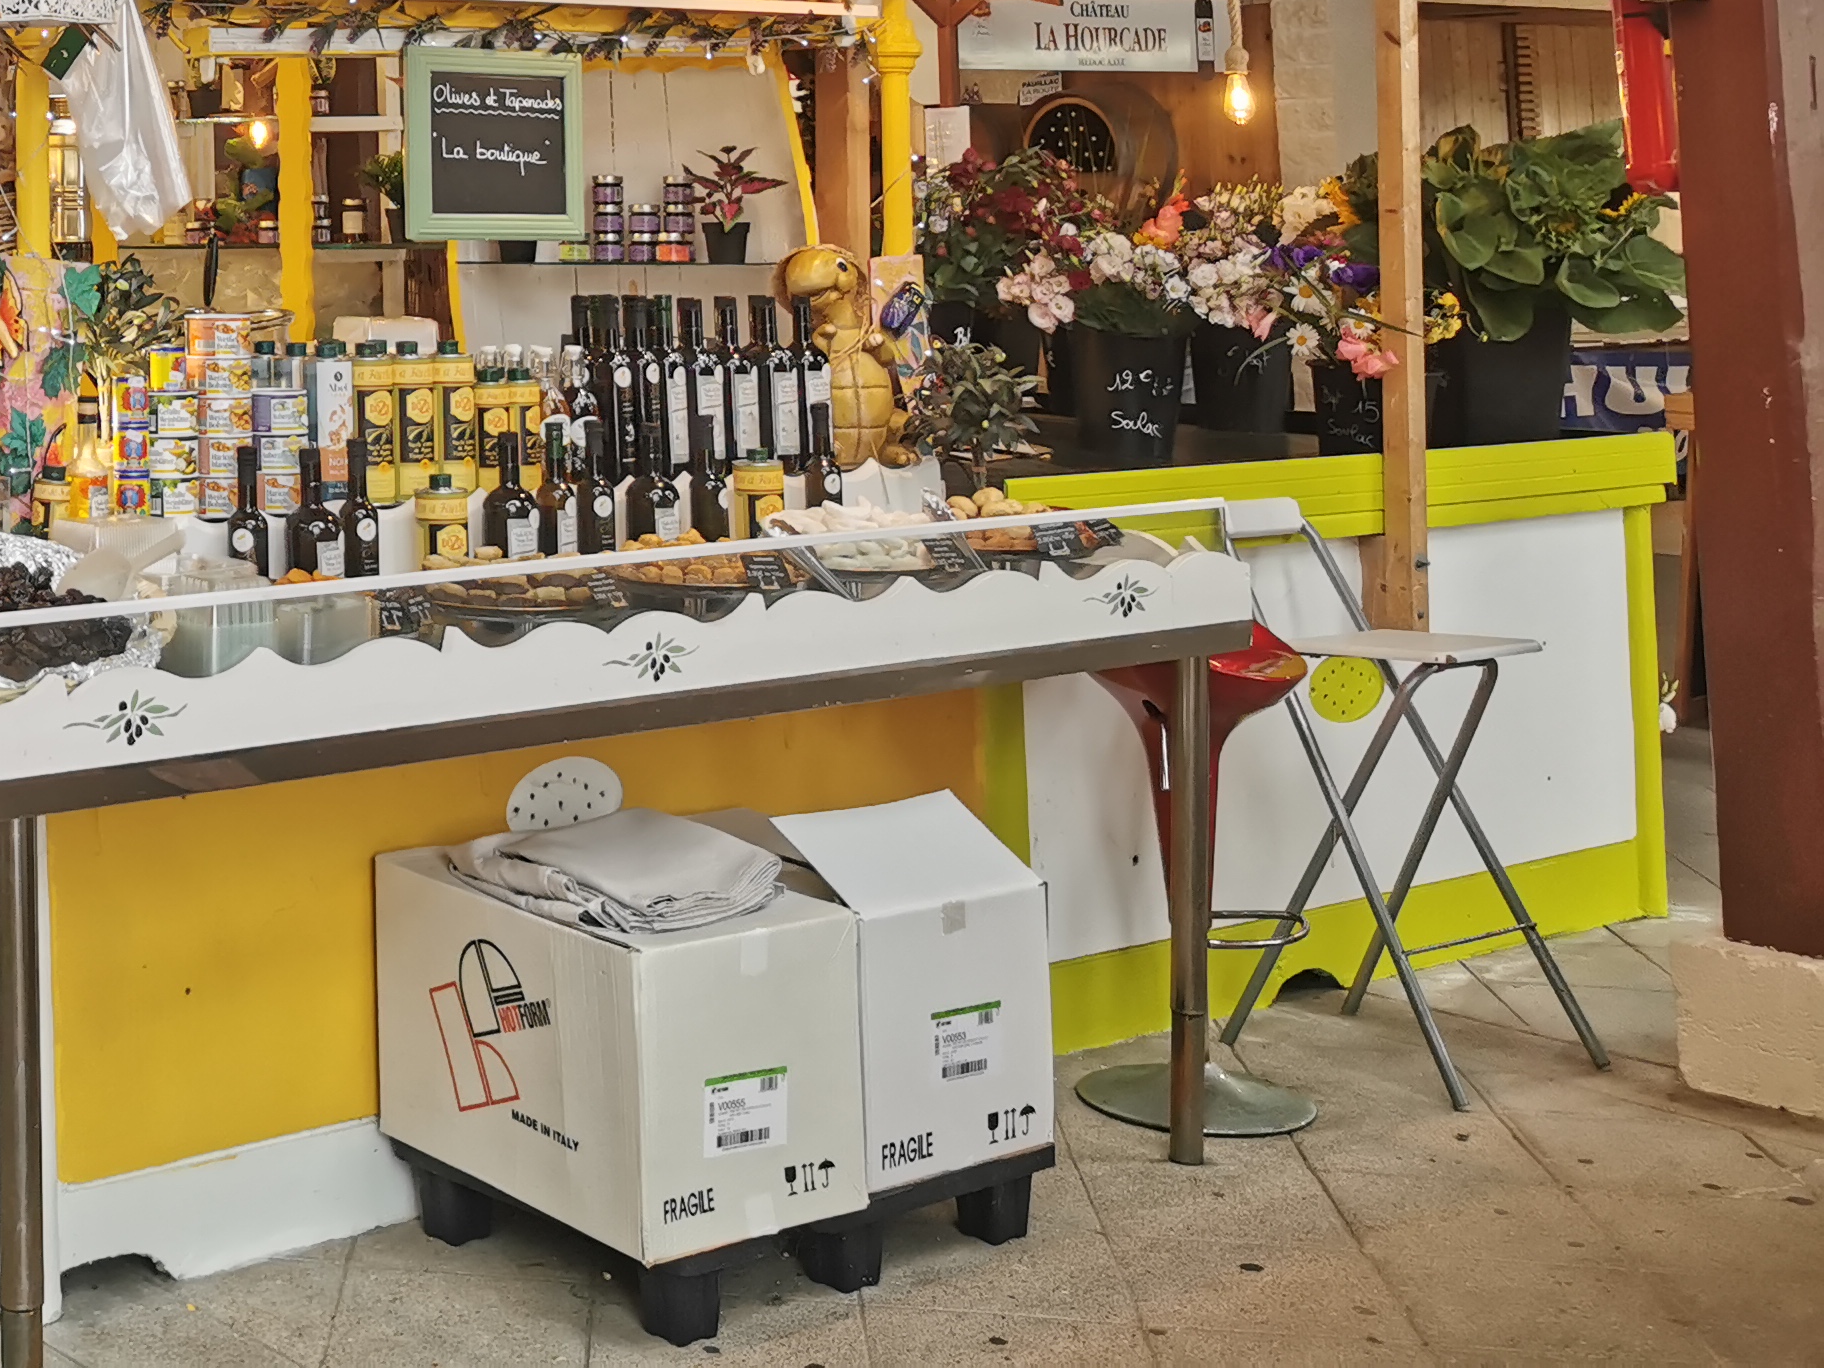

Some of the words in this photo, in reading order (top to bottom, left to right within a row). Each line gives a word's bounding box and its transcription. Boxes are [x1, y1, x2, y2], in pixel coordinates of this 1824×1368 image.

[1069, 0, 1130, 19] CHÂTEAU
[1034, 21, 1060, 51] LA
[1062, 23, 1169, 53] HOURCADE
[433, 82, 481, 106] Olives
[485, 87, 499, 107] et
[499, 88, 563, 112] Tapenades
[1110, 410, 1163, 439] Soulac
[511, 1108, 539, 1132] MADE
[540, 1122, 551, 1138] IN
[552, 1129, 580, 1153] ITALY
[881, 1131, 934, 1171] FRAGILE
[663, 1187, 715, 1226] FRAGILE
